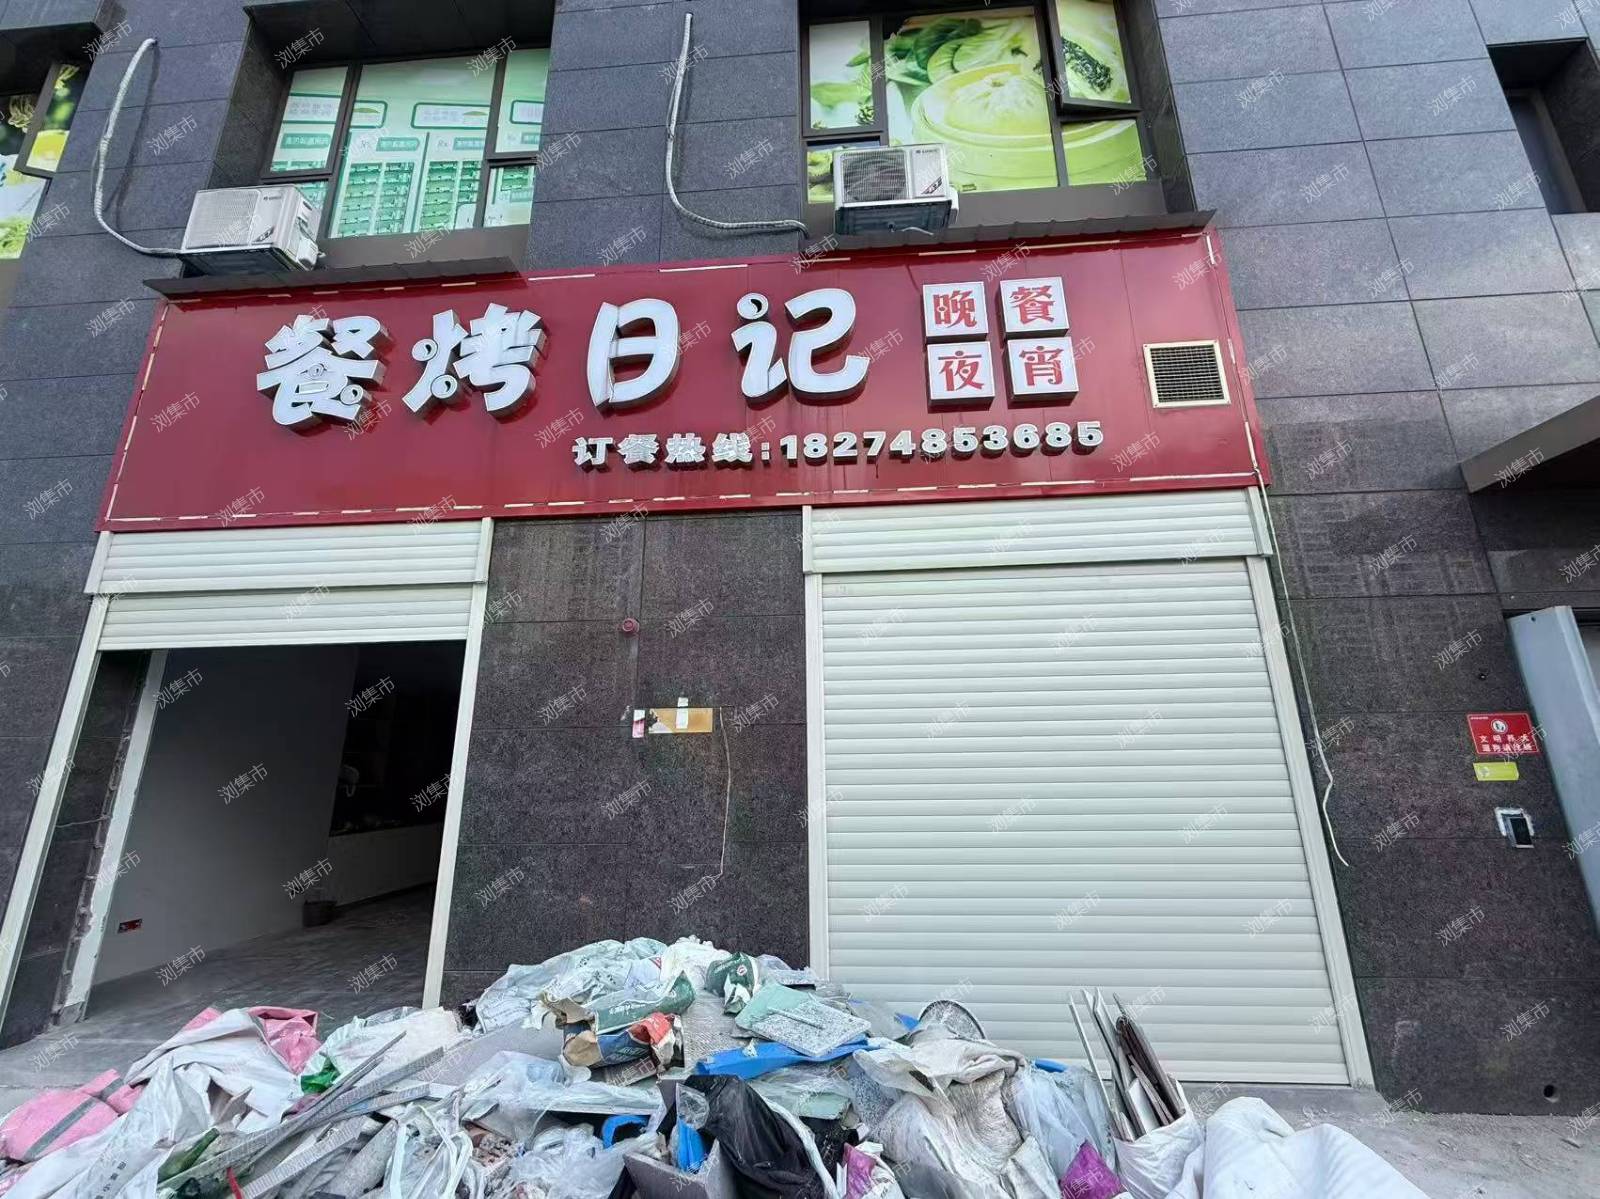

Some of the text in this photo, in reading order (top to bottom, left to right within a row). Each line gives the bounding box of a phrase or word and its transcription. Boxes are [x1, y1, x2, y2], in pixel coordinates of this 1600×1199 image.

[932, 284, 1055, 329] 晚餐
[256, 288, 871, 426] 餐烤日记
[937, 345, 1065, 392] 夜宵
